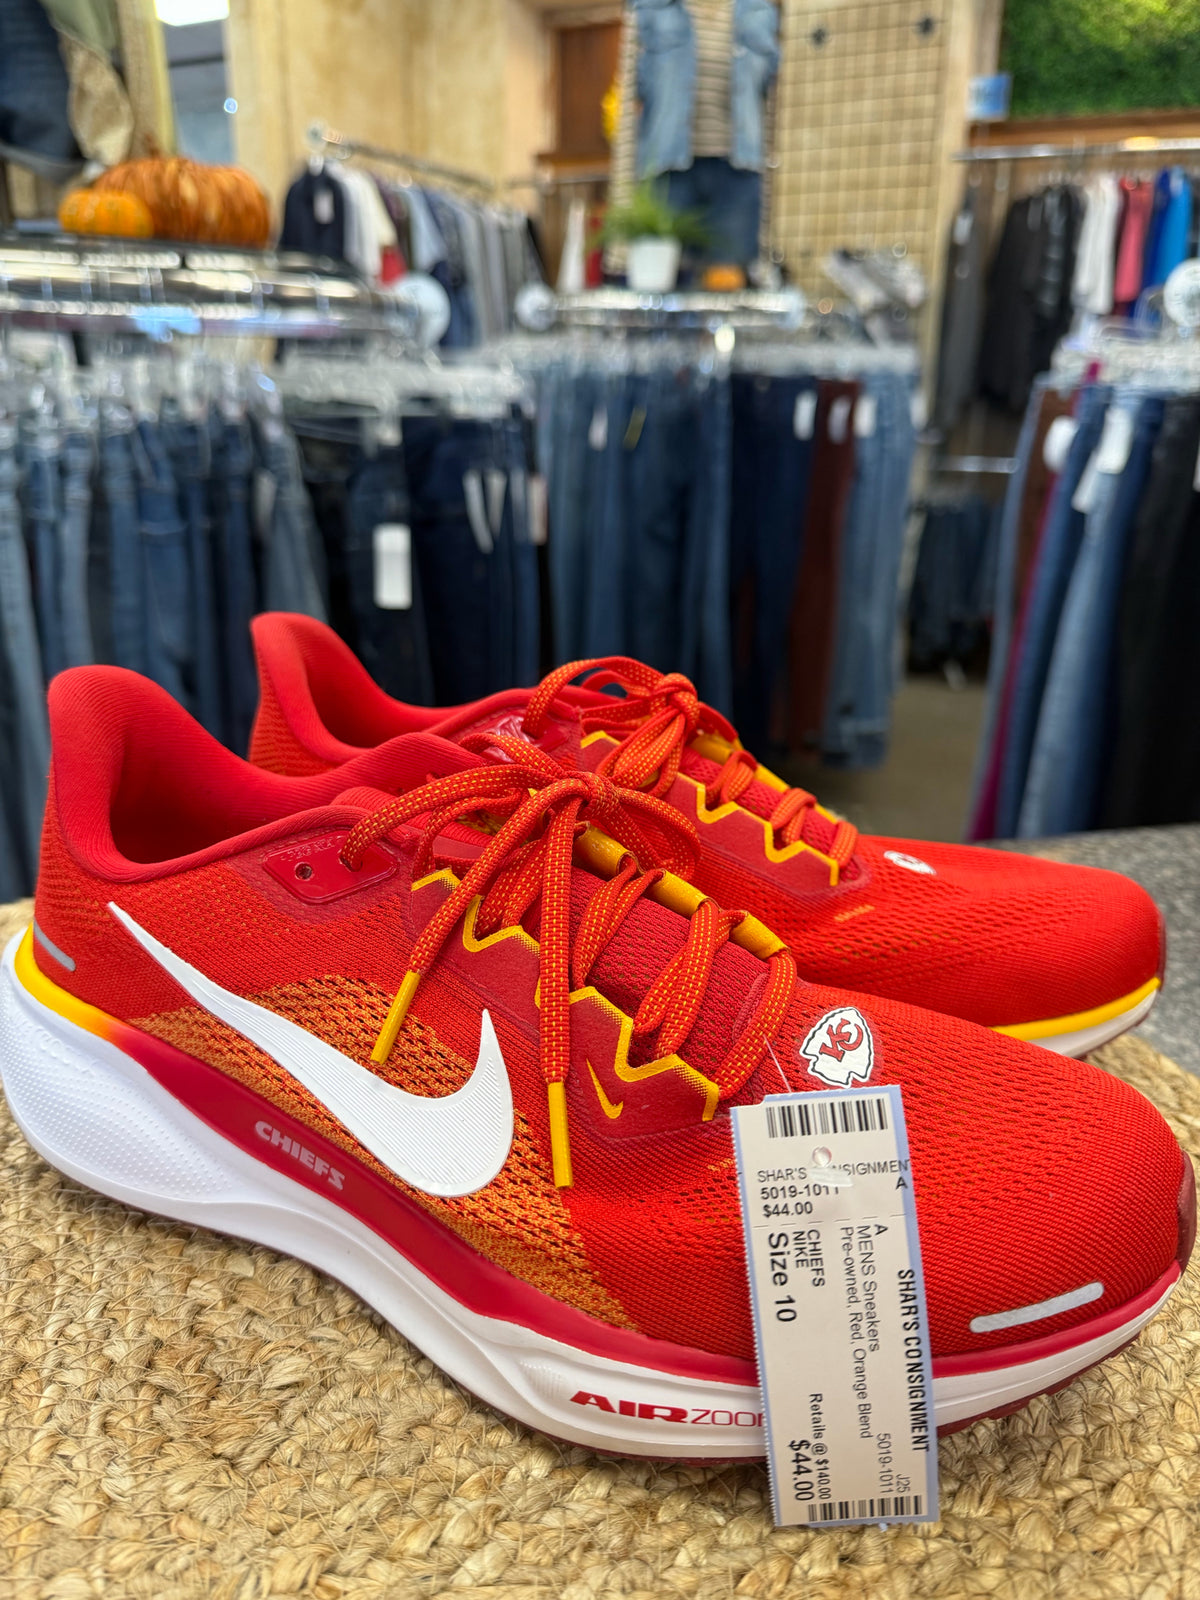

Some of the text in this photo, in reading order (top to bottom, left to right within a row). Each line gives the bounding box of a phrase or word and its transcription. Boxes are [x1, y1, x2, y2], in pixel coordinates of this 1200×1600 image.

[255, 1121, 345, 1190] CHIEFS
[757, 1159, 910, 1183] SHAR'S SIGNMEN
[763, 1201, 813, 1218] $44.00
[895, 1177, 908, 1190] A
[793, 1231, 809, 1268] NIKE
[874, 1224, 888, 1235] A
[768, 1232, 797, 1323] Size 10
[808, 1229, 825, 1287] CHIEFS
[840, 1227, 861, 1308] Pre-owned,
[857, 1225, 880, 1352] MENS Sneakers
[853, 1348, 867, 1400] Orange
[897, 1269, 929, 1452] SHAR'S CONSIGNMENT
[570, 1390, 689, 1423] AIR
[858, 1402, 873, 1439] Blend
[789, 1439, 815, 1501] $44.00
[809, 1393, 832, 1500] Retails @ $140.00
[896, 1474, 910, 1493] J25
